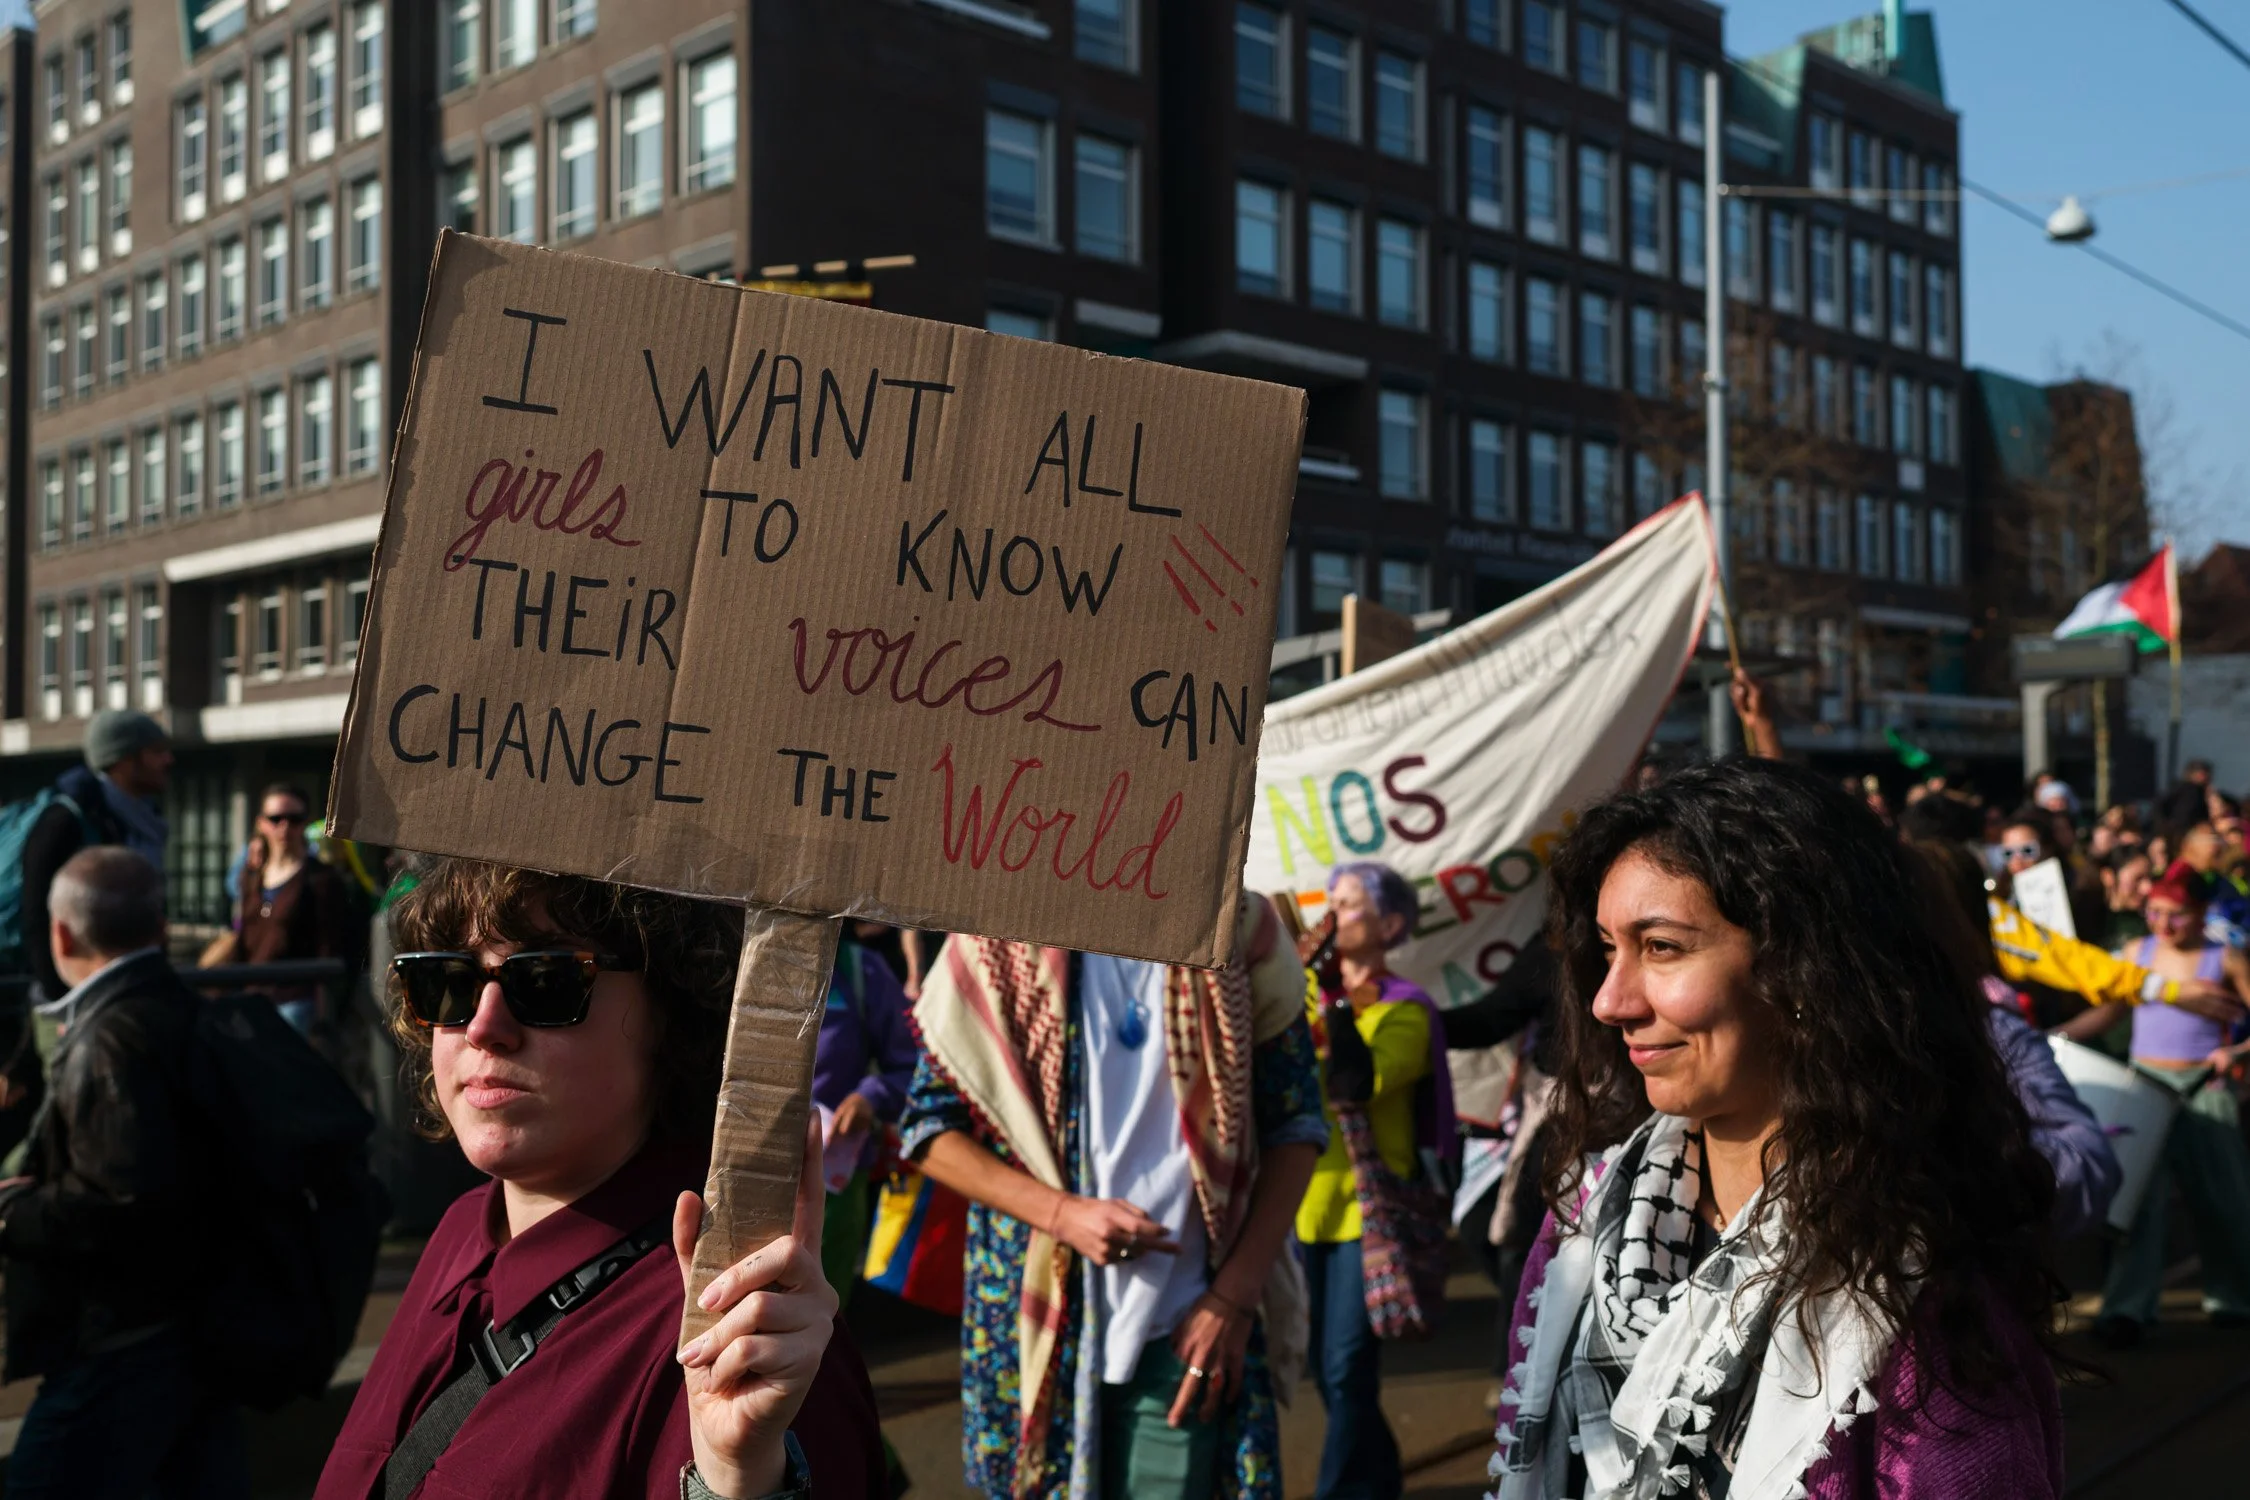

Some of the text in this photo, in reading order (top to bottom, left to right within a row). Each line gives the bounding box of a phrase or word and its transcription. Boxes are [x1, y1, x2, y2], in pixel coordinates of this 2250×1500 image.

[481, 307, 1183, 519] I WANT ALL
[443, 448, 642, 572] girls
[700, 488, 800, 564] TO
[895, 508, 1124, 617] KNOW
[788, 615, 1102, 732] voices
[1129, 669, 1250, 762] CAN
[387, 684, 1184, 900] CHANGE THE World
[1266, 755, 1447, 876] NOS
